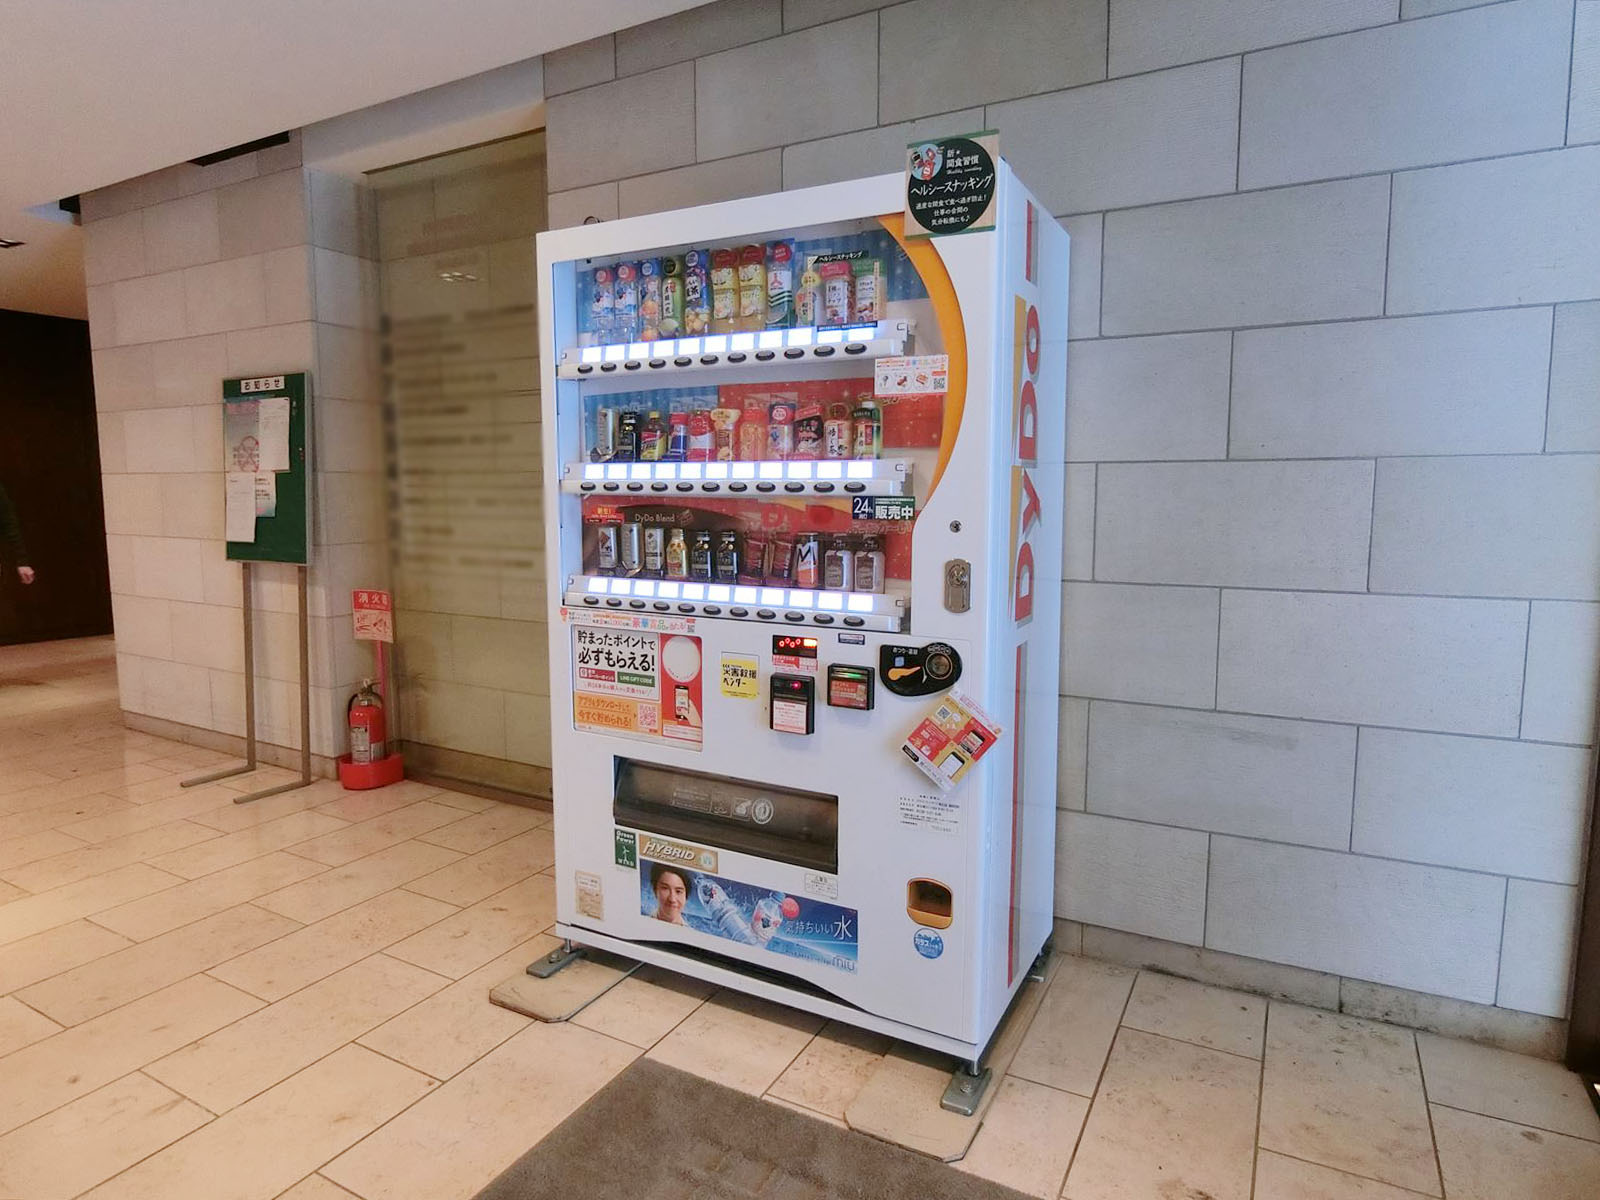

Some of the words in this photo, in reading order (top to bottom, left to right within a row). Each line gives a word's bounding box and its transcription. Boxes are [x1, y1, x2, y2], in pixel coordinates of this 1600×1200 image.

[910, 173, 994, 196] ヘルシースナッキング
[244, 379, 281, 391] お知らせ
[635, 513, 654, 523] DyDo
[875, 505, 913, 520] 販売中
[577, 629, 656, 651] 貯まったポイントで
[578, 646, 655, 672] 必ずもらえる!
[723, 668, 757, 679] 災害救援
[643, 841, 695, 860] HYBRID
